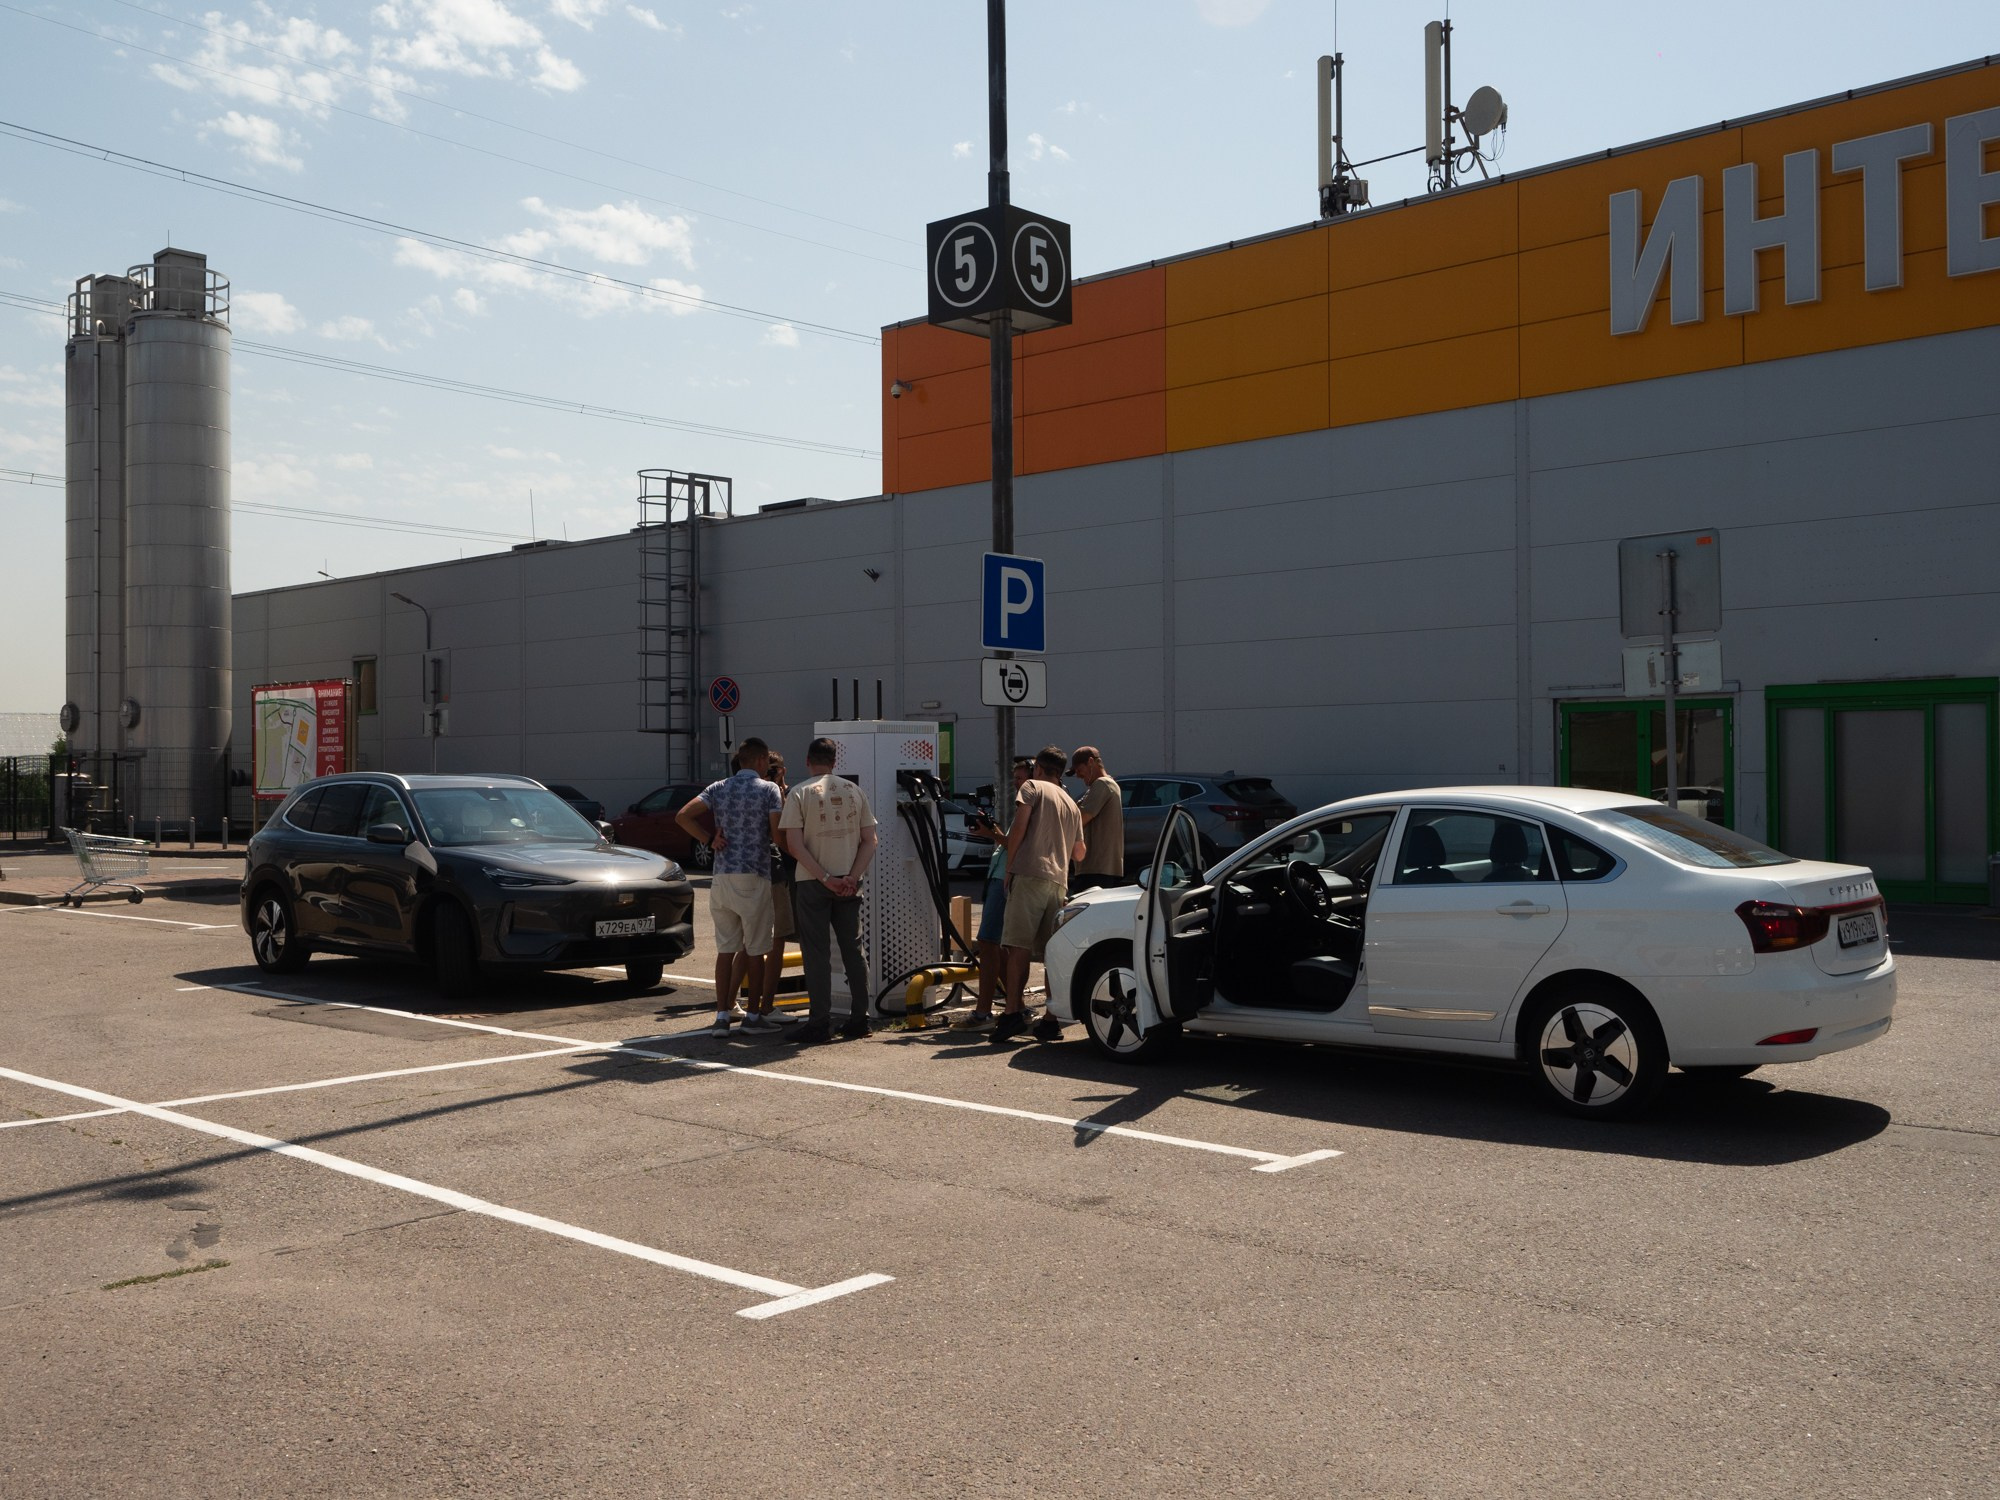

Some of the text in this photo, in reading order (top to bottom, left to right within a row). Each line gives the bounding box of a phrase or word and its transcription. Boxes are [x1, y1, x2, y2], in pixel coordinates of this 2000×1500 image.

[1609, 106, 2000, 336] ИНТЕ
[954, 235, 977, 292] 5
[1029, 235, 1049, 292] 5
[1000, 565, 1034, 639] P
